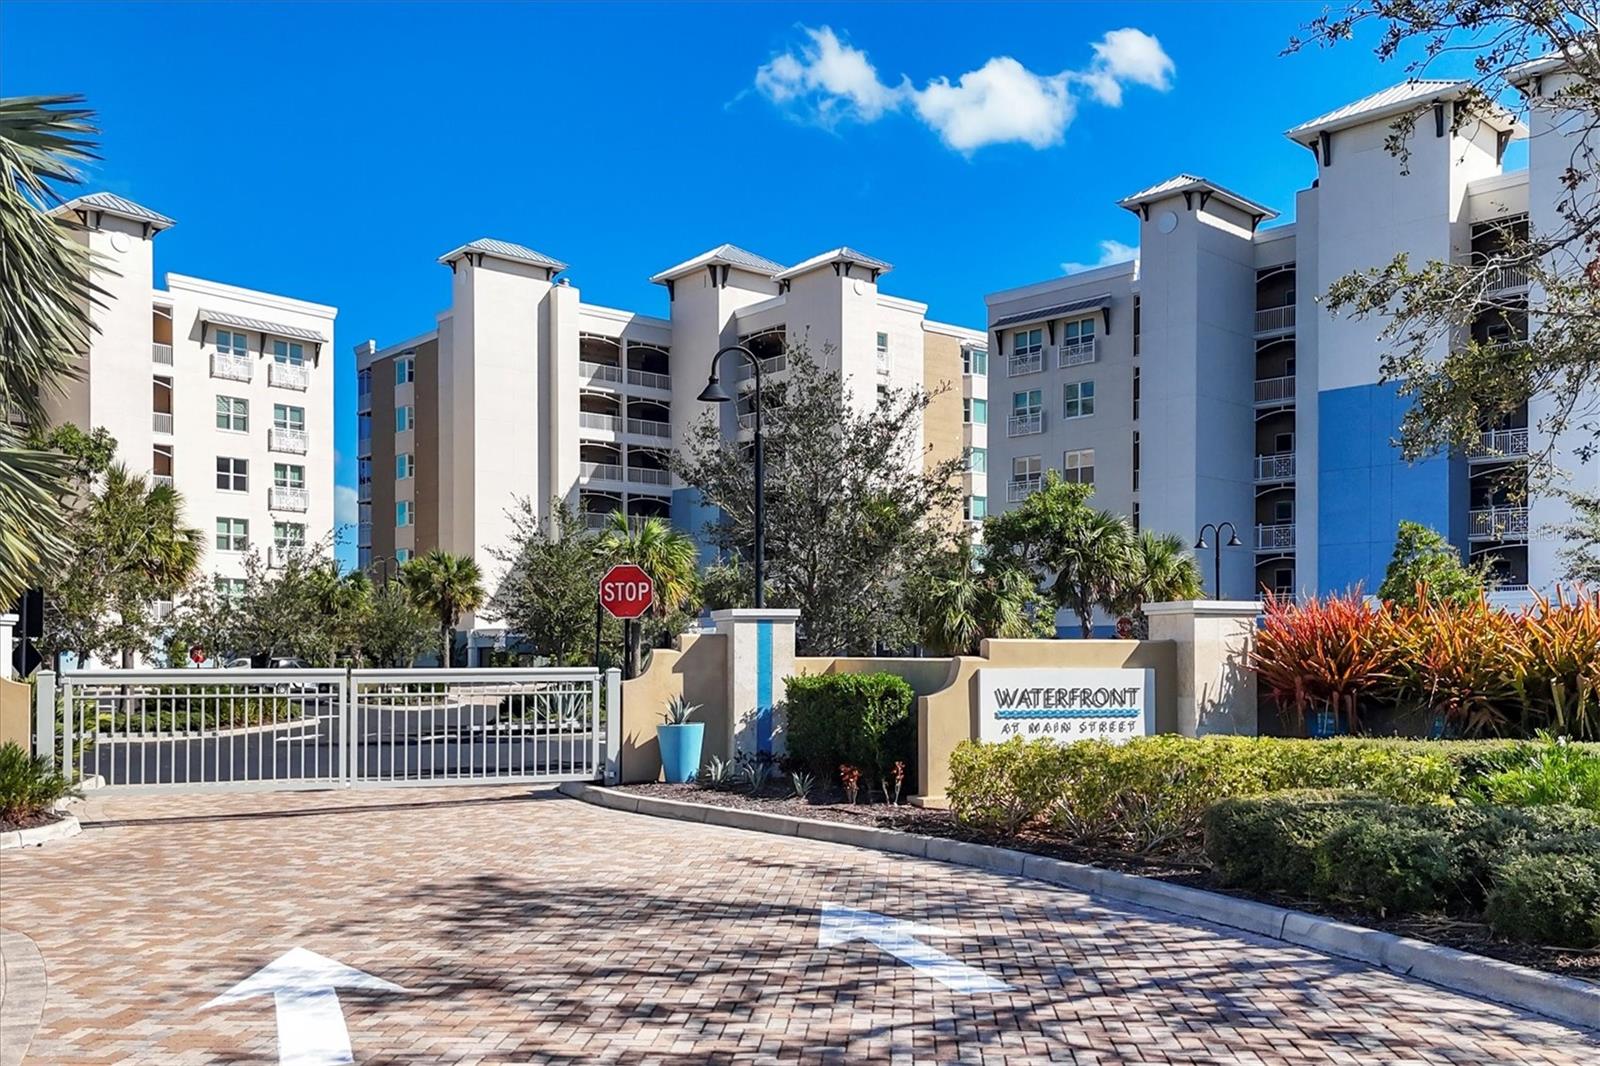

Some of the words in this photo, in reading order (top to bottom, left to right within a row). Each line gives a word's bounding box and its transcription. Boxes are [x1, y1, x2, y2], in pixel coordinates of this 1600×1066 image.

[604, 582, 649, 601] STOP
[994, 688, 1140, 709] WATERFRONT
[1001, 722, 1020, 735] AT
[1028, 721, 1071, 734] MAIN
[1079, 721, 1136, 734] STREET
